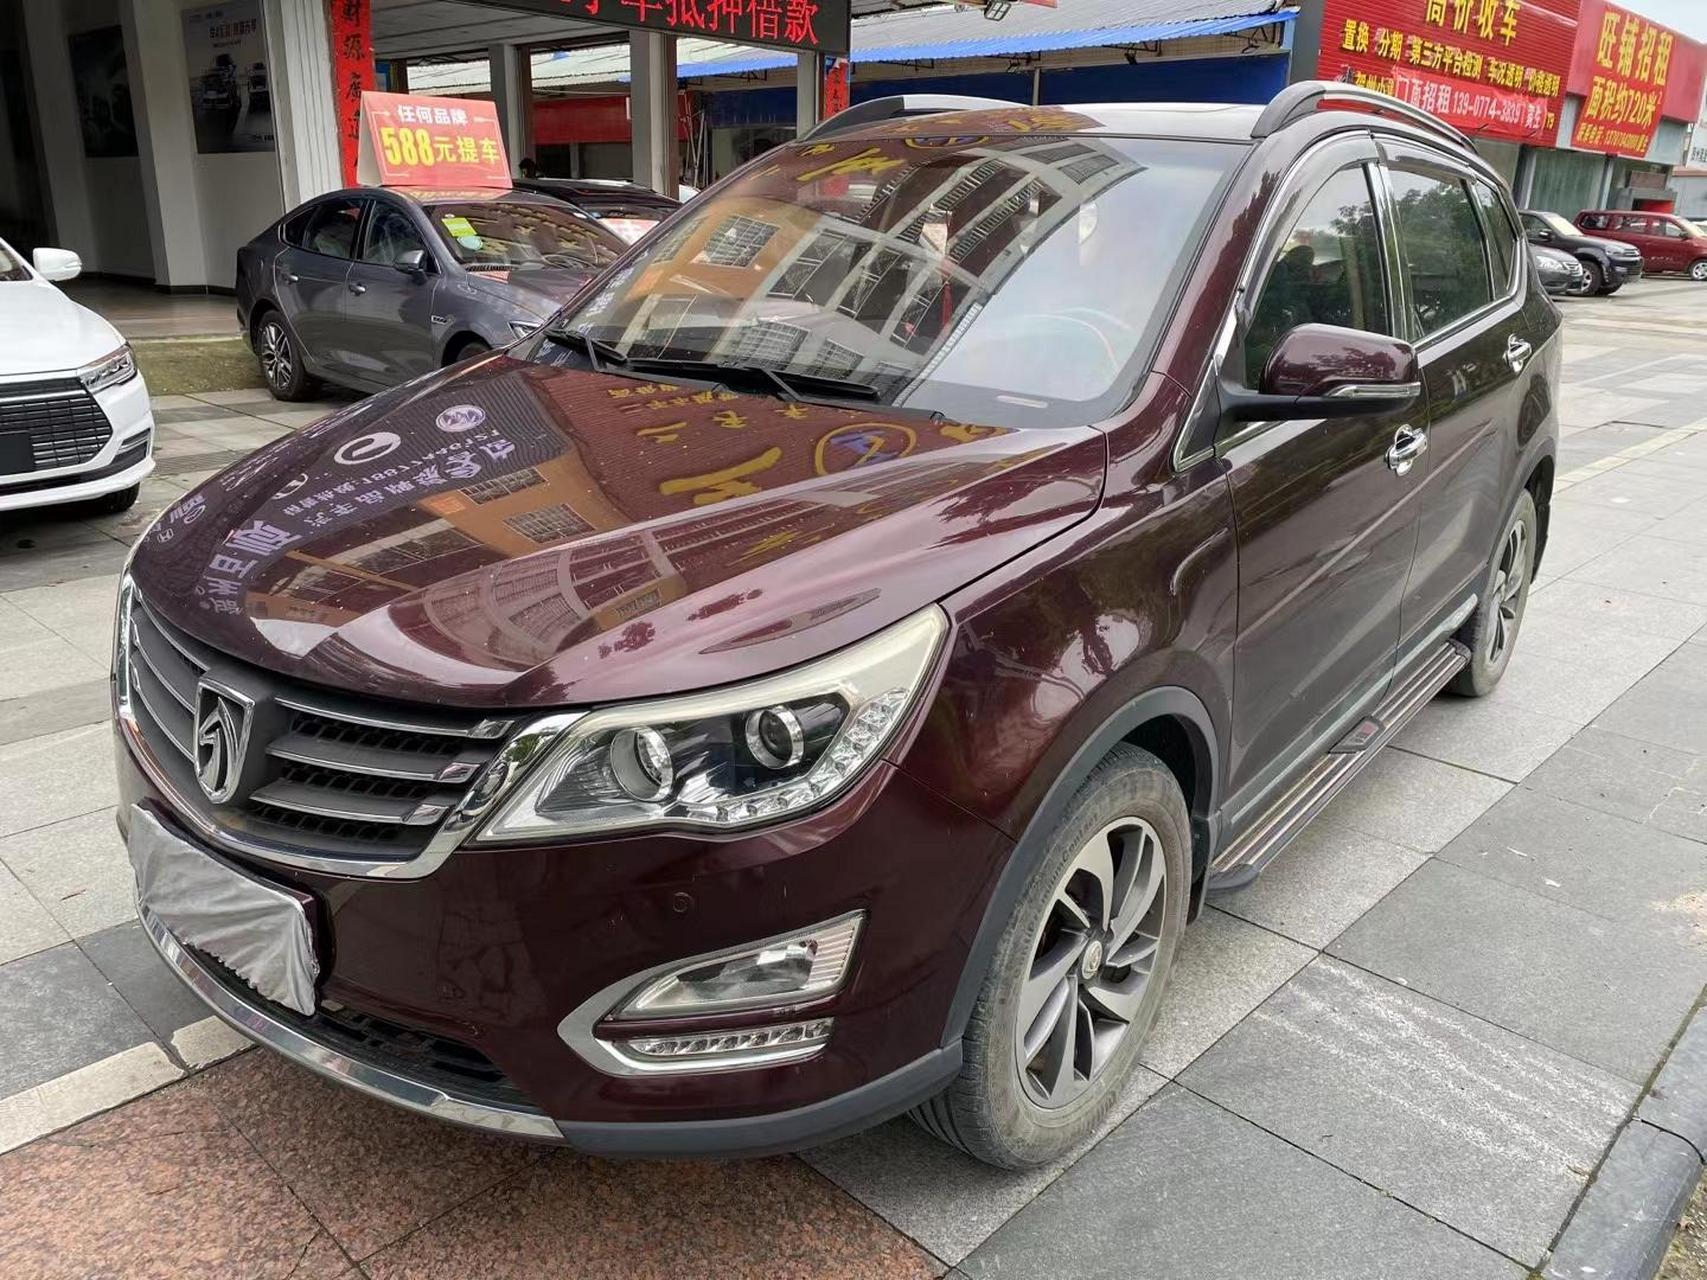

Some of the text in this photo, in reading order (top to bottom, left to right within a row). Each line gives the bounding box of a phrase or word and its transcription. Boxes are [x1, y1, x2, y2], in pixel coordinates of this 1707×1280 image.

[1342, 18, 1370, 53] 置换
[1597, 11, 1674, 86] 旺铺招租
[397, 104, 468, 126] 任何品牌
[380, 127, 500, 166] 588元提车
